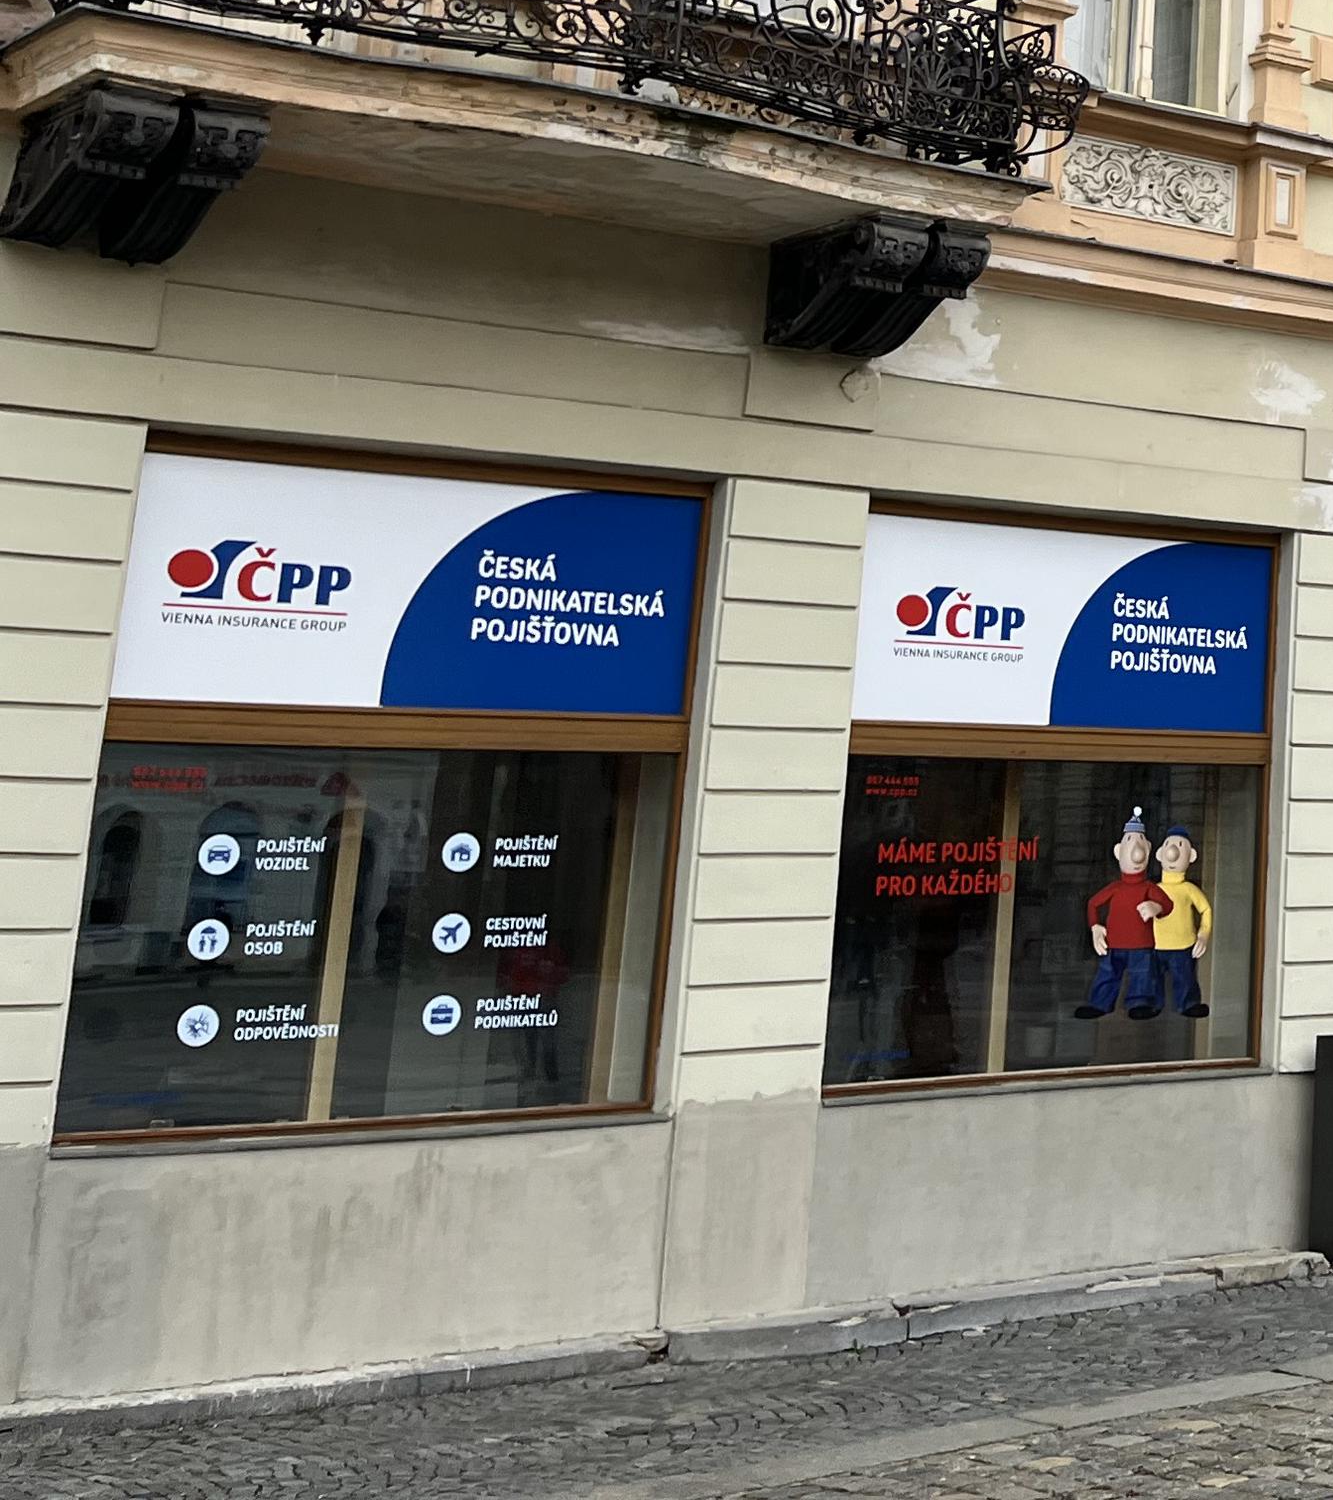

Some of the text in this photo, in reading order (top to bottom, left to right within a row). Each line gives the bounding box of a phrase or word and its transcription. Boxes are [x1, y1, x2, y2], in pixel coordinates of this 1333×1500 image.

[478, 549, 557, 582] ČESKÁ
[238, 547, 352, 606] ČPP
[474, 585, 665, 618] PODNIKATELSKÁ
[1113, 592, 1170, 620] ČESKÁ
[161, 611, 347, 632] VIENNA INSURANCE GROUP
[945, 592, 1026, 641] ČPP
[470, 614, 620, 647] POJIŠŤOVNA
[1111, 622, 1248, 650] PODNIKATELSKÁ
[893, 647, 1024, 663] VIENNA INSURANCE GROUP
[1110, 647, 1216, 675] POJIŠŤOVNA
[256, 836, 328, 853] POJIŠTĚNÍ
[495, 835, 559, 851] POJIŠTĚNÍ
[877, 835, 1041, 864] MÁME POJIŠTĚNÍ
[255, 857, 310, 871] VOZIDEL
[492, 854, 550, 868] MAJETKU
[876, 868, 1014, 897] PRO KAŽDÉHO
[246, 919, 317, 938] POJIŠTĚNÍ
[485, 913, 548, 931] CESTOVNÍ
[244, 940, 284, 956] OSOB
[483, 930, 548, 948] POJIŠTĚNÍ
[476, 993, 542, 1012] POJIŠTĚNÍ
[235, 1004, 307, 1023] POJIŠTĚNÍ
[474, 1009, 559, 1030] PODNIKATELŮ
[233, 1023, 339, 1042] ODPOVĚDNOSTI
